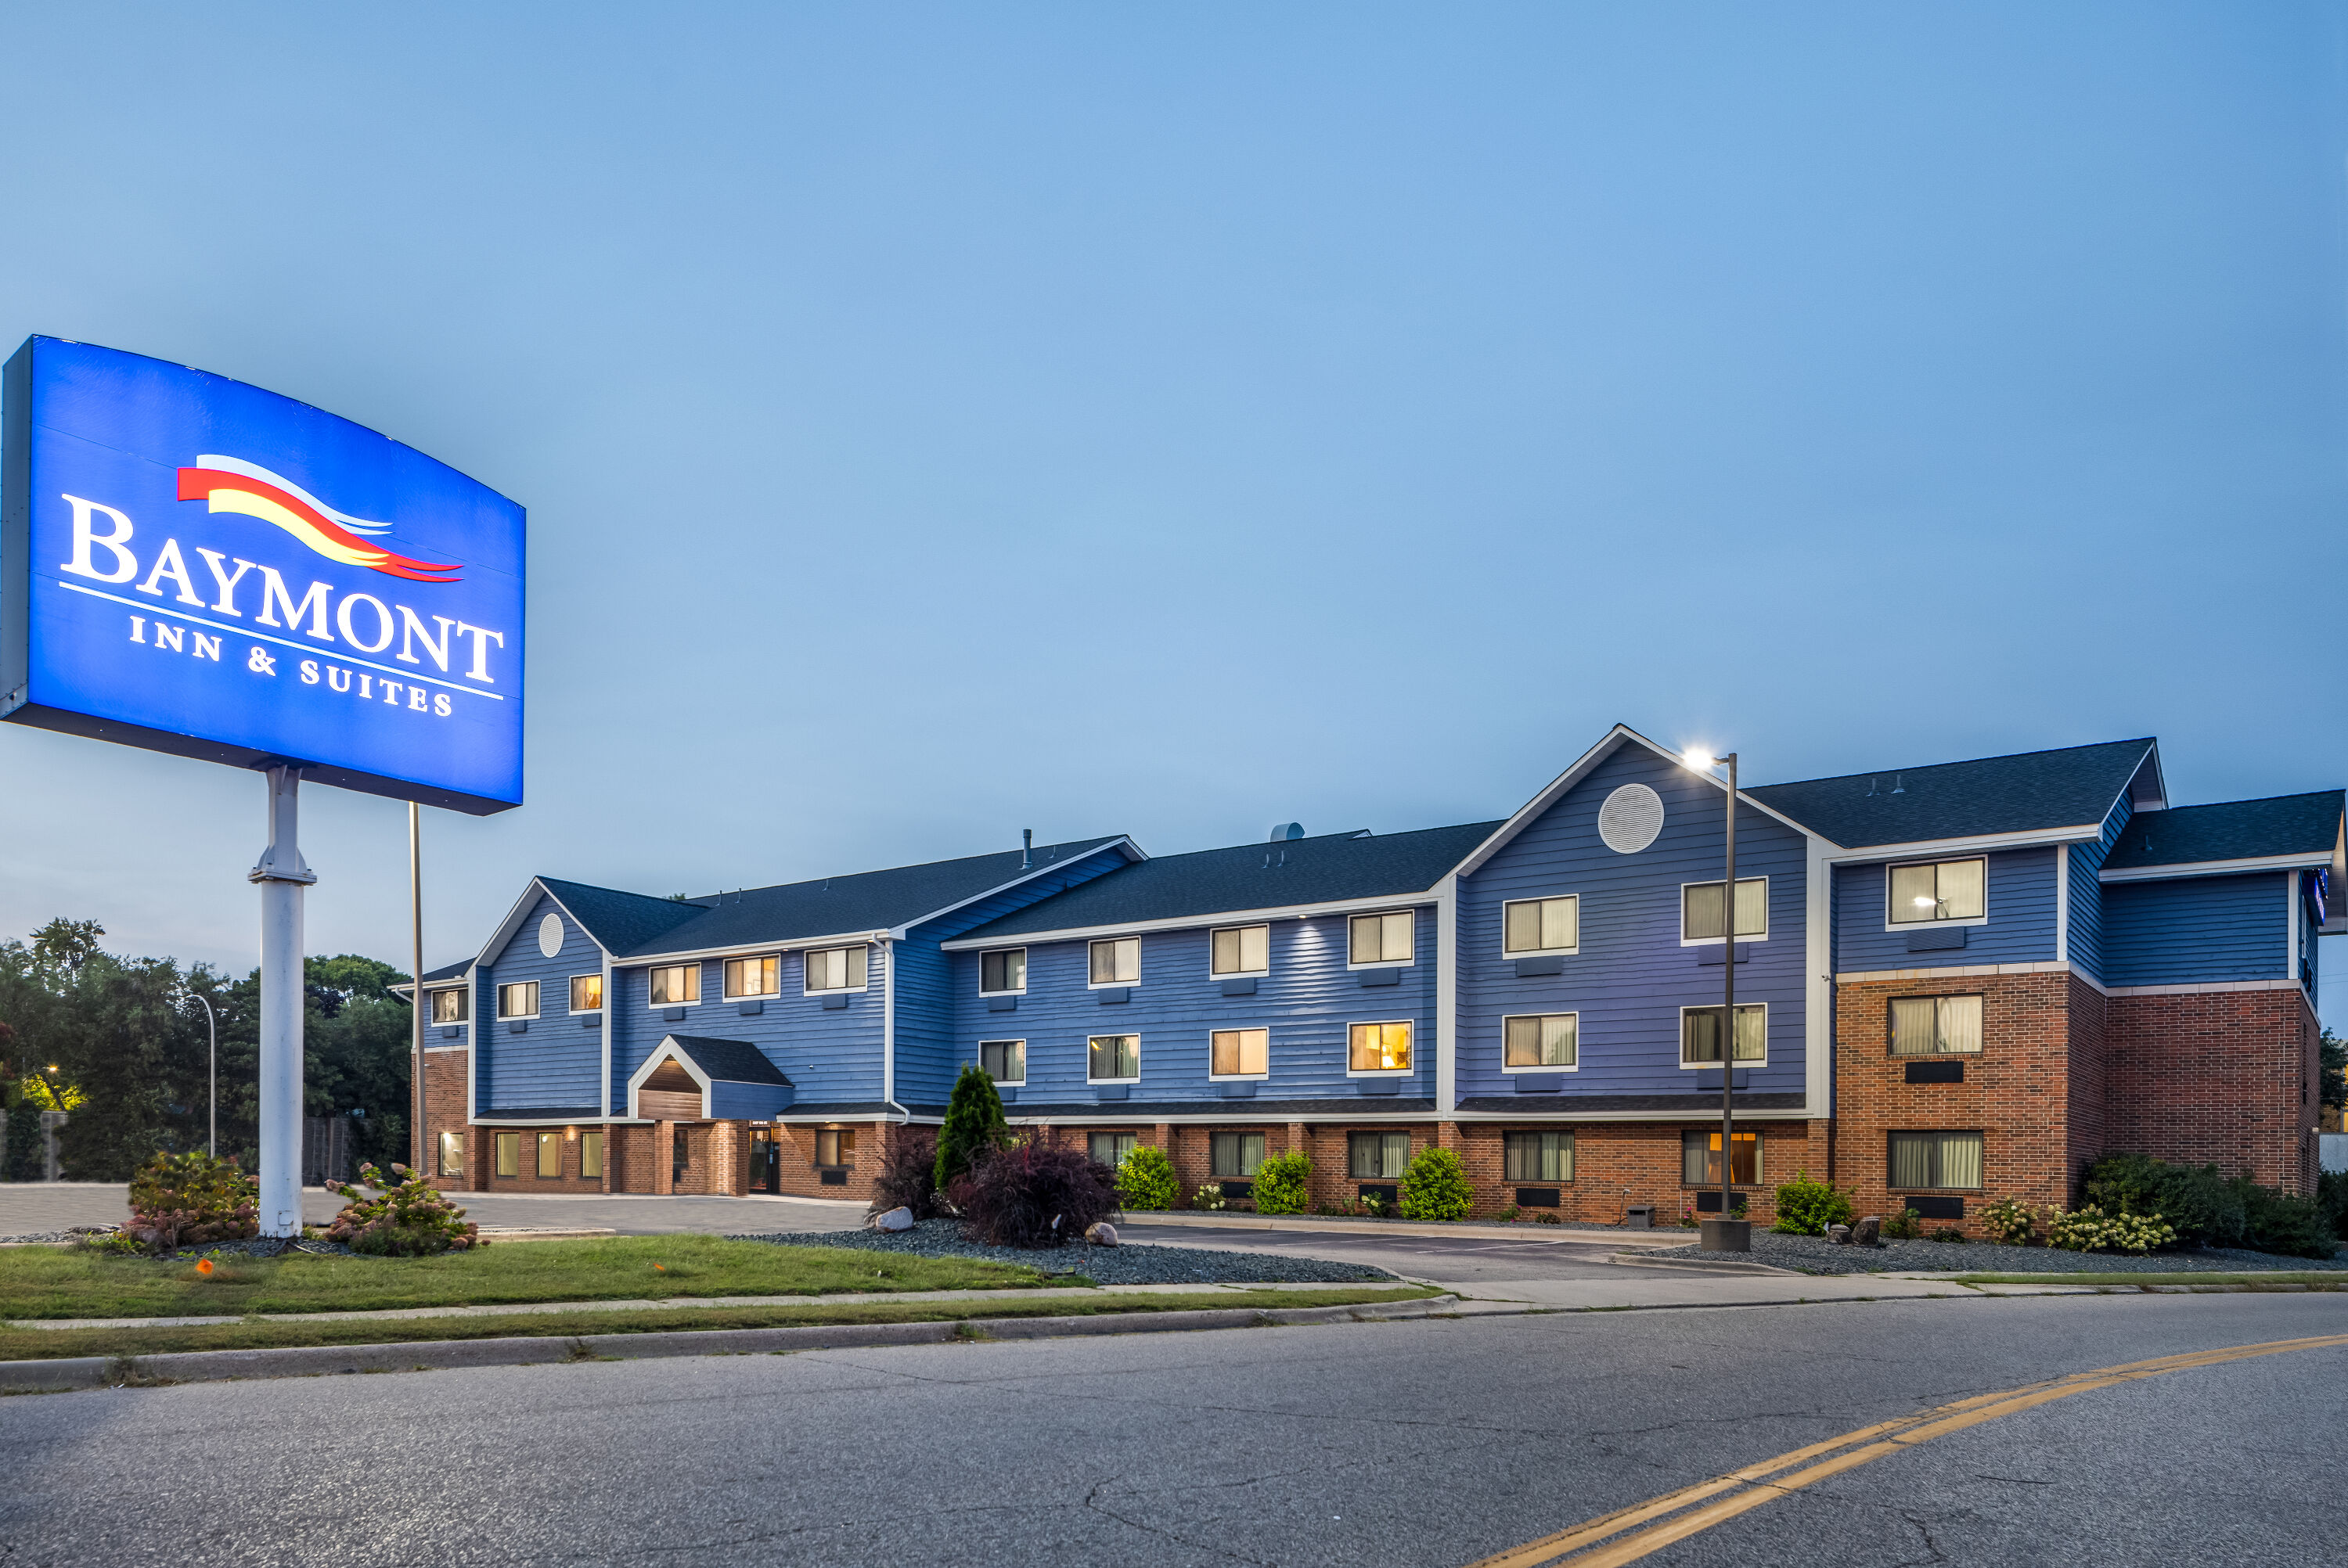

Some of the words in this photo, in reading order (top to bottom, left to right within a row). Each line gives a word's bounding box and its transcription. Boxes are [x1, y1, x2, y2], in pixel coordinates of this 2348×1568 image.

[60, 493, 504, 684] BAYMONT
[129, 615, 222, 662] INN
[248, 646, 276, 677] &
[300, 660, 452, 717] SUITES
